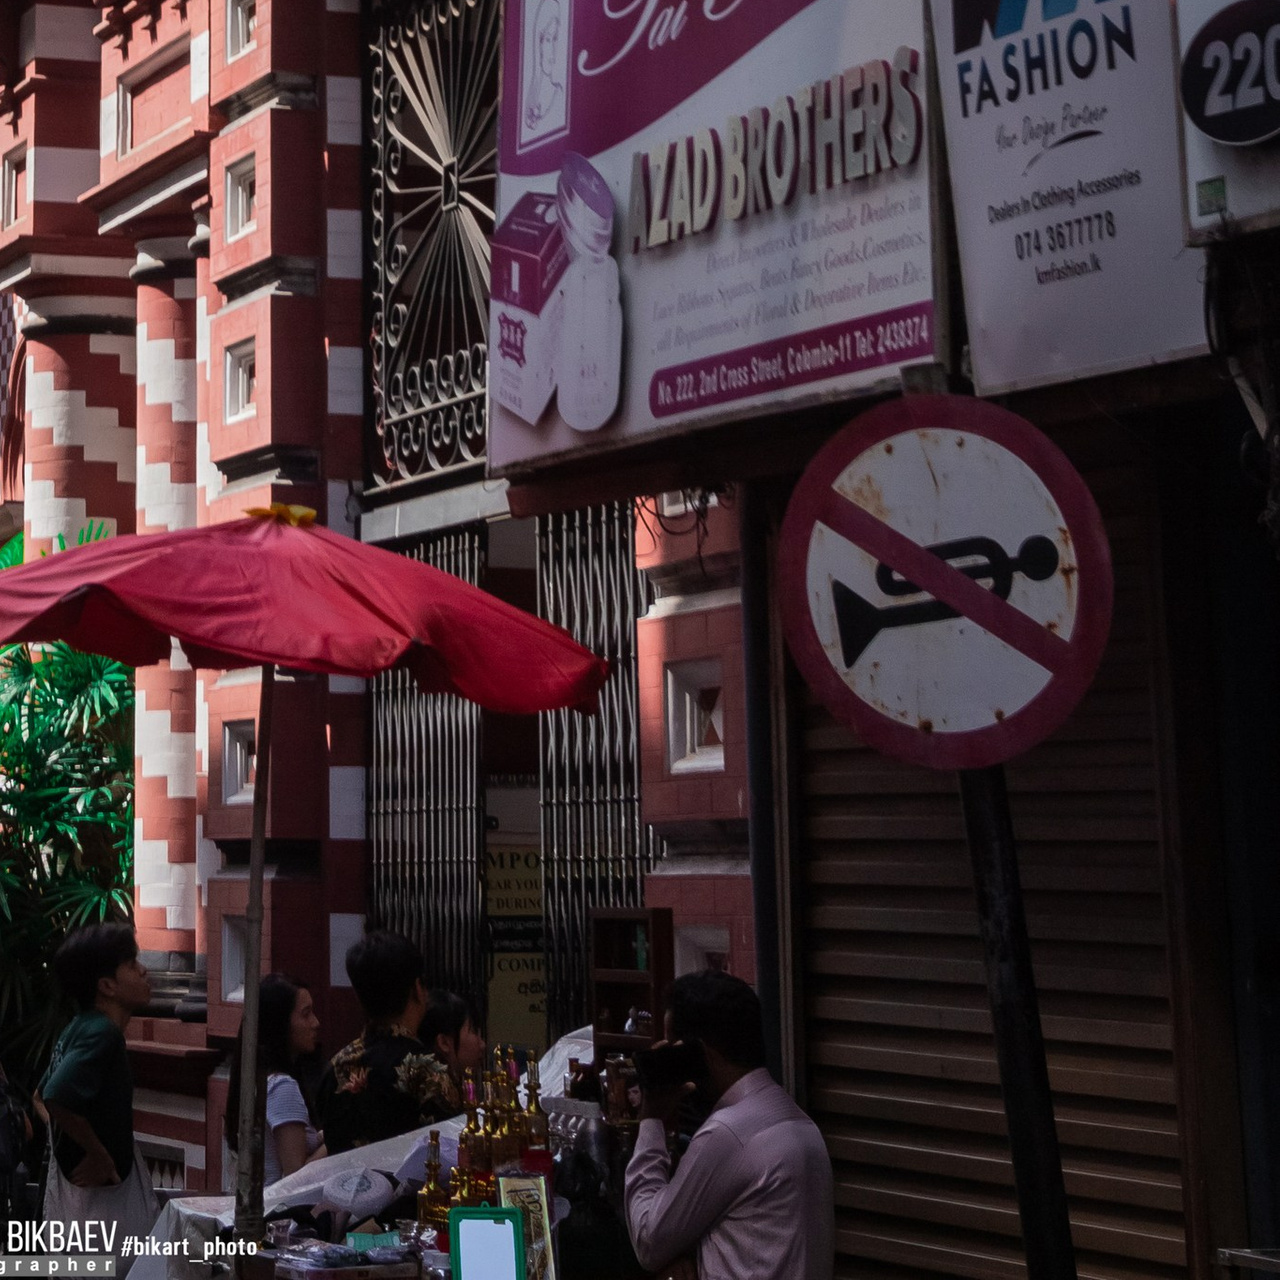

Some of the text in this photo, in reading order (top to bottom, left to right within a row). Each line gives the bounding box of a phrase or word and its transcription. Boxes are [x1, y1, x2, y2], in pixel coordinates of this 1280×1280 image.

[956, 5, 1137, 119] FASHION
[726, 45, 921, 221] BROTHERS
[1014, 209, 1117, 261] 074 3677778
[699, 366, 718, 397] 2nd
[719, 363, 749, 392] Cross
